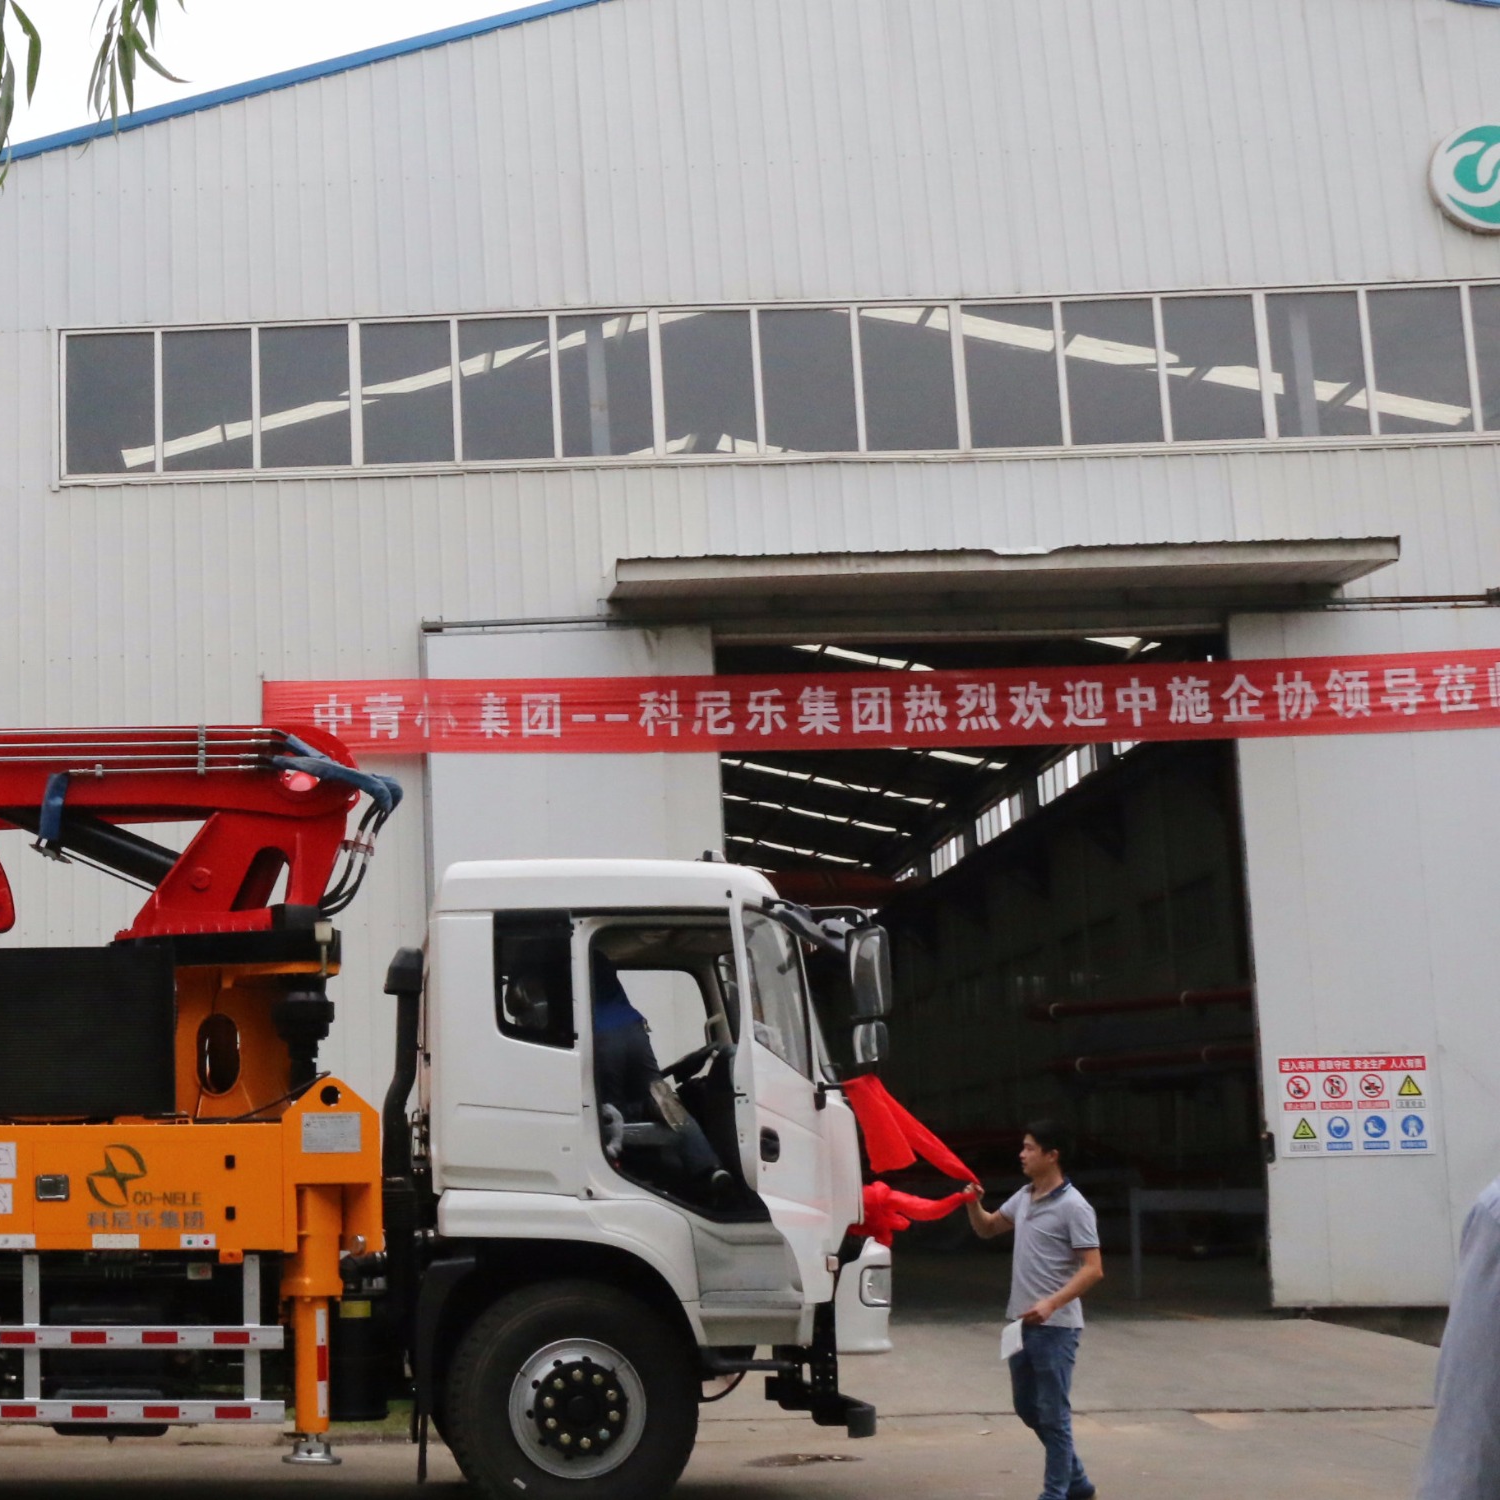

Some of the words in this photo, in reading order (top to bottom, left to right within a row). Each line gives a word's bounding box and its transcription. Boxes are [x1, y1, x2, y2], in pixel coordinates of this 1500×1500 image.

[1354, 1059, 1386, 1069] 安全生产
[133, 1191, 202, 1206] CO-NELE
